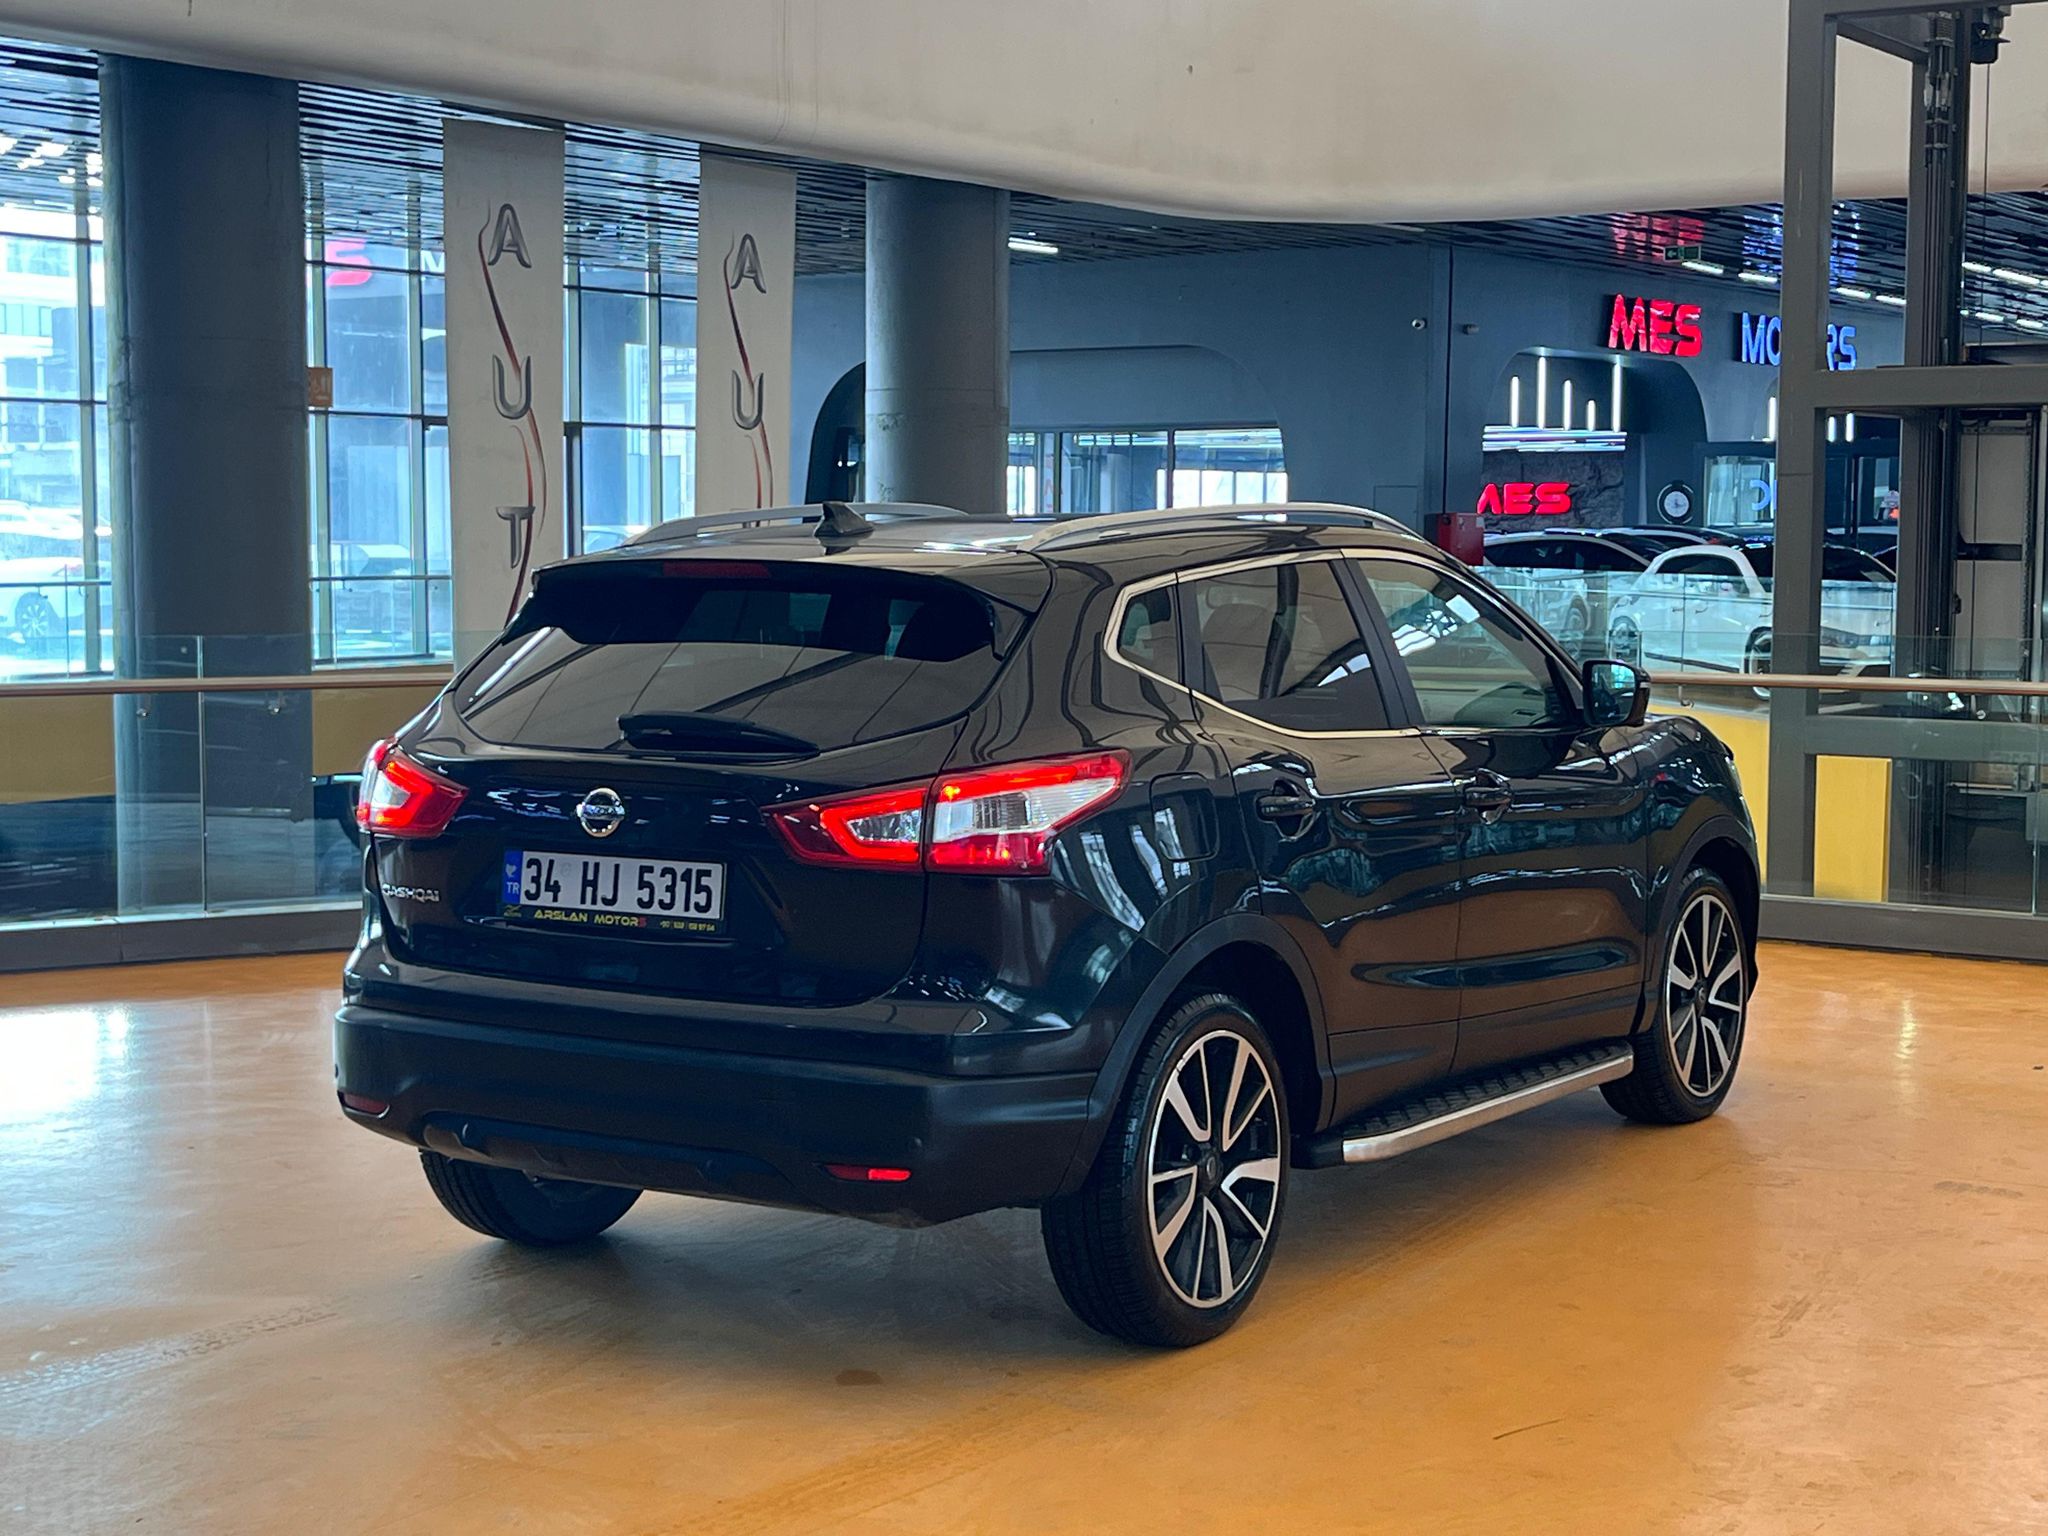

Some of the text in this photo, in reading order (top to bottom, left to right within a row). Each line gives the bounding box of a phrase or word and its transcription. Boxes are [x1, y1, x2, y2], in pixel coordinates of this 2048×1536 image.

[730, 234, 767, 430] AU
[1608, 293, 1857, 371] MES MORS
[487, 204, 536, 569] AUT
[506, 881, 521, 896] TR
[524, 858, 713, 914] 34 HJ 5315
[534, 909, 588, 923] ARSLAN
[593, 914, 647, 928] MOTORS
